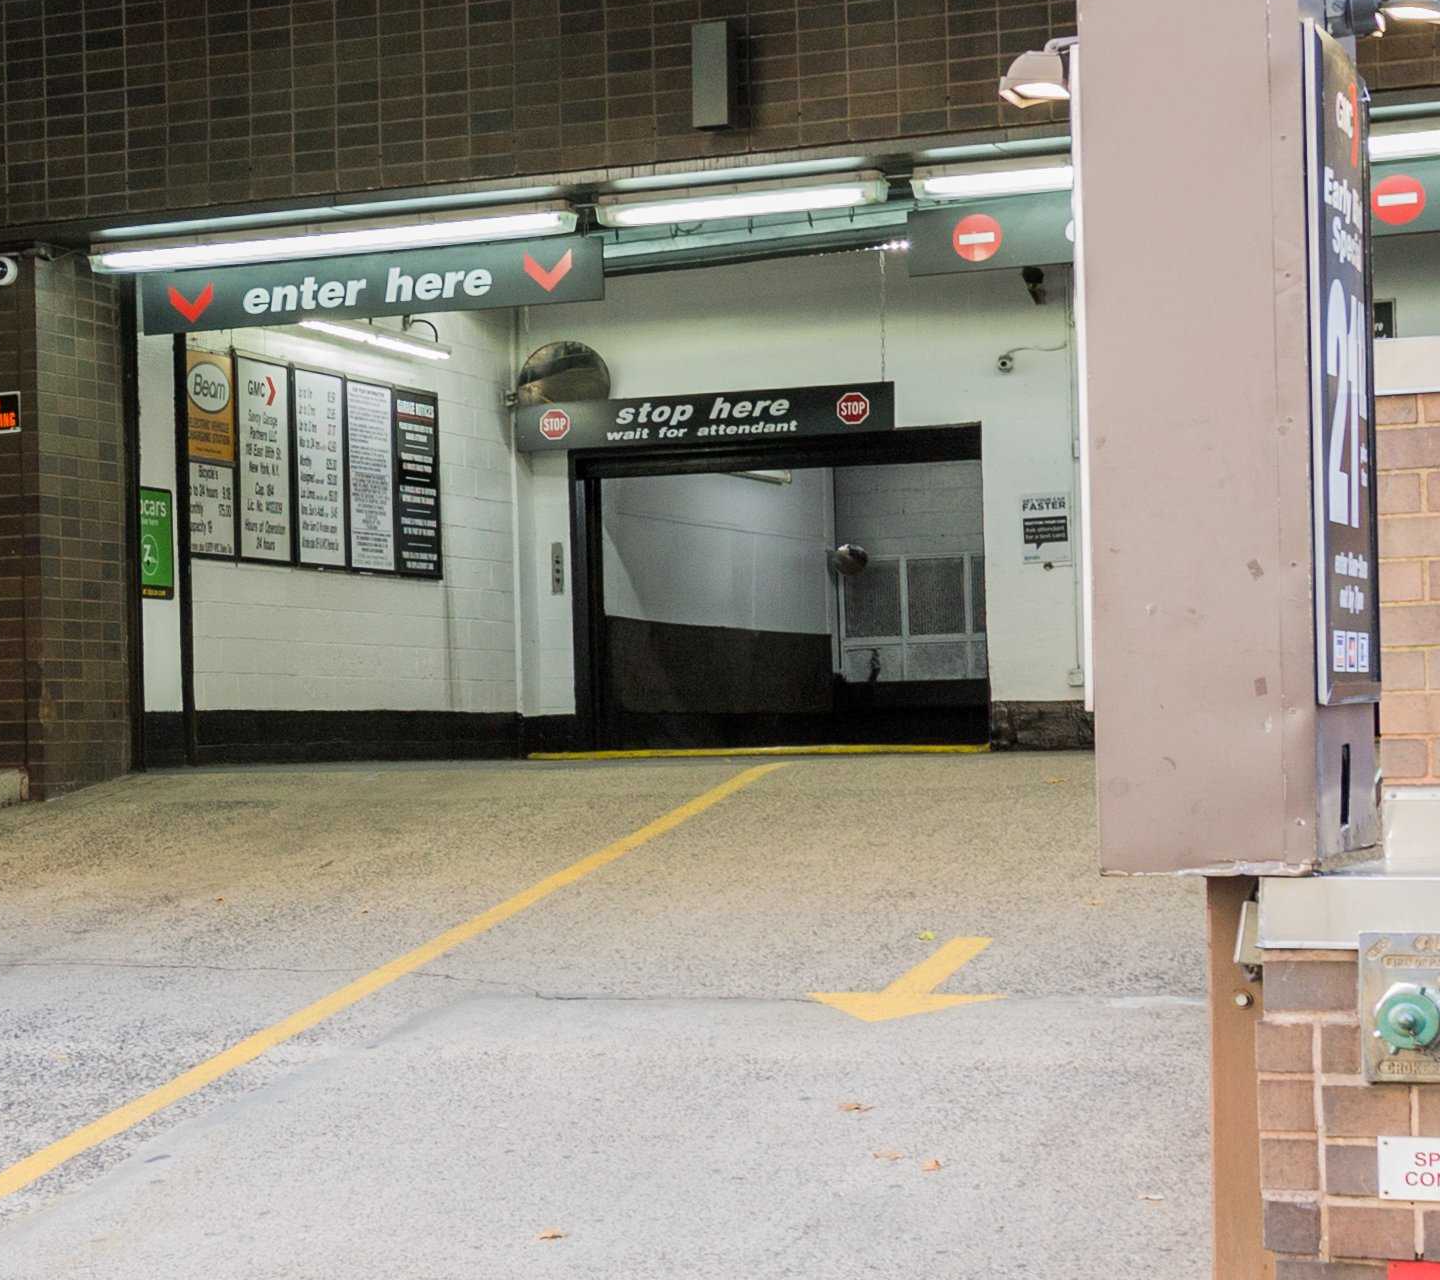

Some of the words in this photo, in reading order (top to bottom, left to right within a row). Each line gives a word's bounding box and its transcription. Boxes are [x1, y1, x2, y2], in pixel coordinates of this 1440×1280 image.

[243, 276, 367, 315] enter
[384, 267, 493, 304] here
[193, 372, 226, 402] Beam
[247, 379, 266, 398] GMC
[616, 400, 693, 426] stop
[709, 397, 790, 420] here
[840, 401, 866, 416] STOP
[543, 417, 567, 431] STOP
[606, 428, 649, 441] wait
[658, 426, 688, 439] for
[696, 420, 799, 437] attendant
[1022, 500, 1066, 512] FASTER
